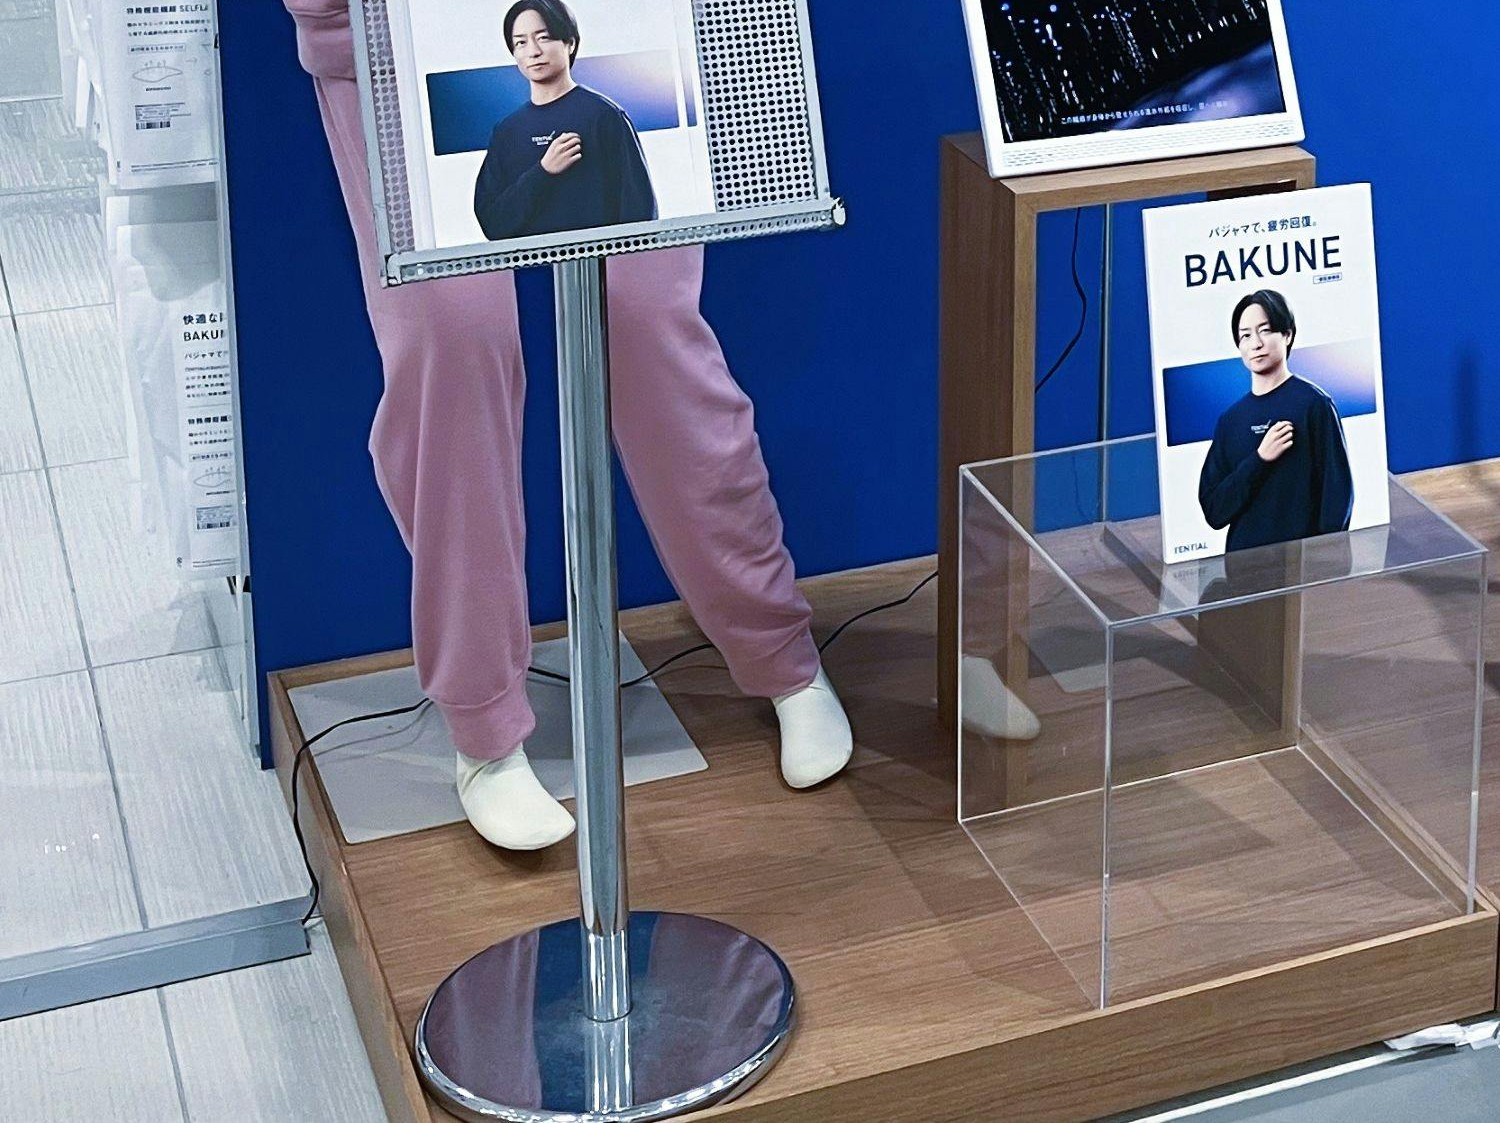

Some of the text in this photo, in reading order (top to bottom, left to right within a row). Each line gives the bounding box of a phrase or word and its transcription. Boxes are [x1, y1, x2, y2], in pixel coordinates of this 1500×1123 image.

[1208, 215, 1317, 238] パジャマで、疲労回復。
[1185, 235, 1342, 288] BAKUNE
[1174, 542, 1208, 554] TENTIAL
